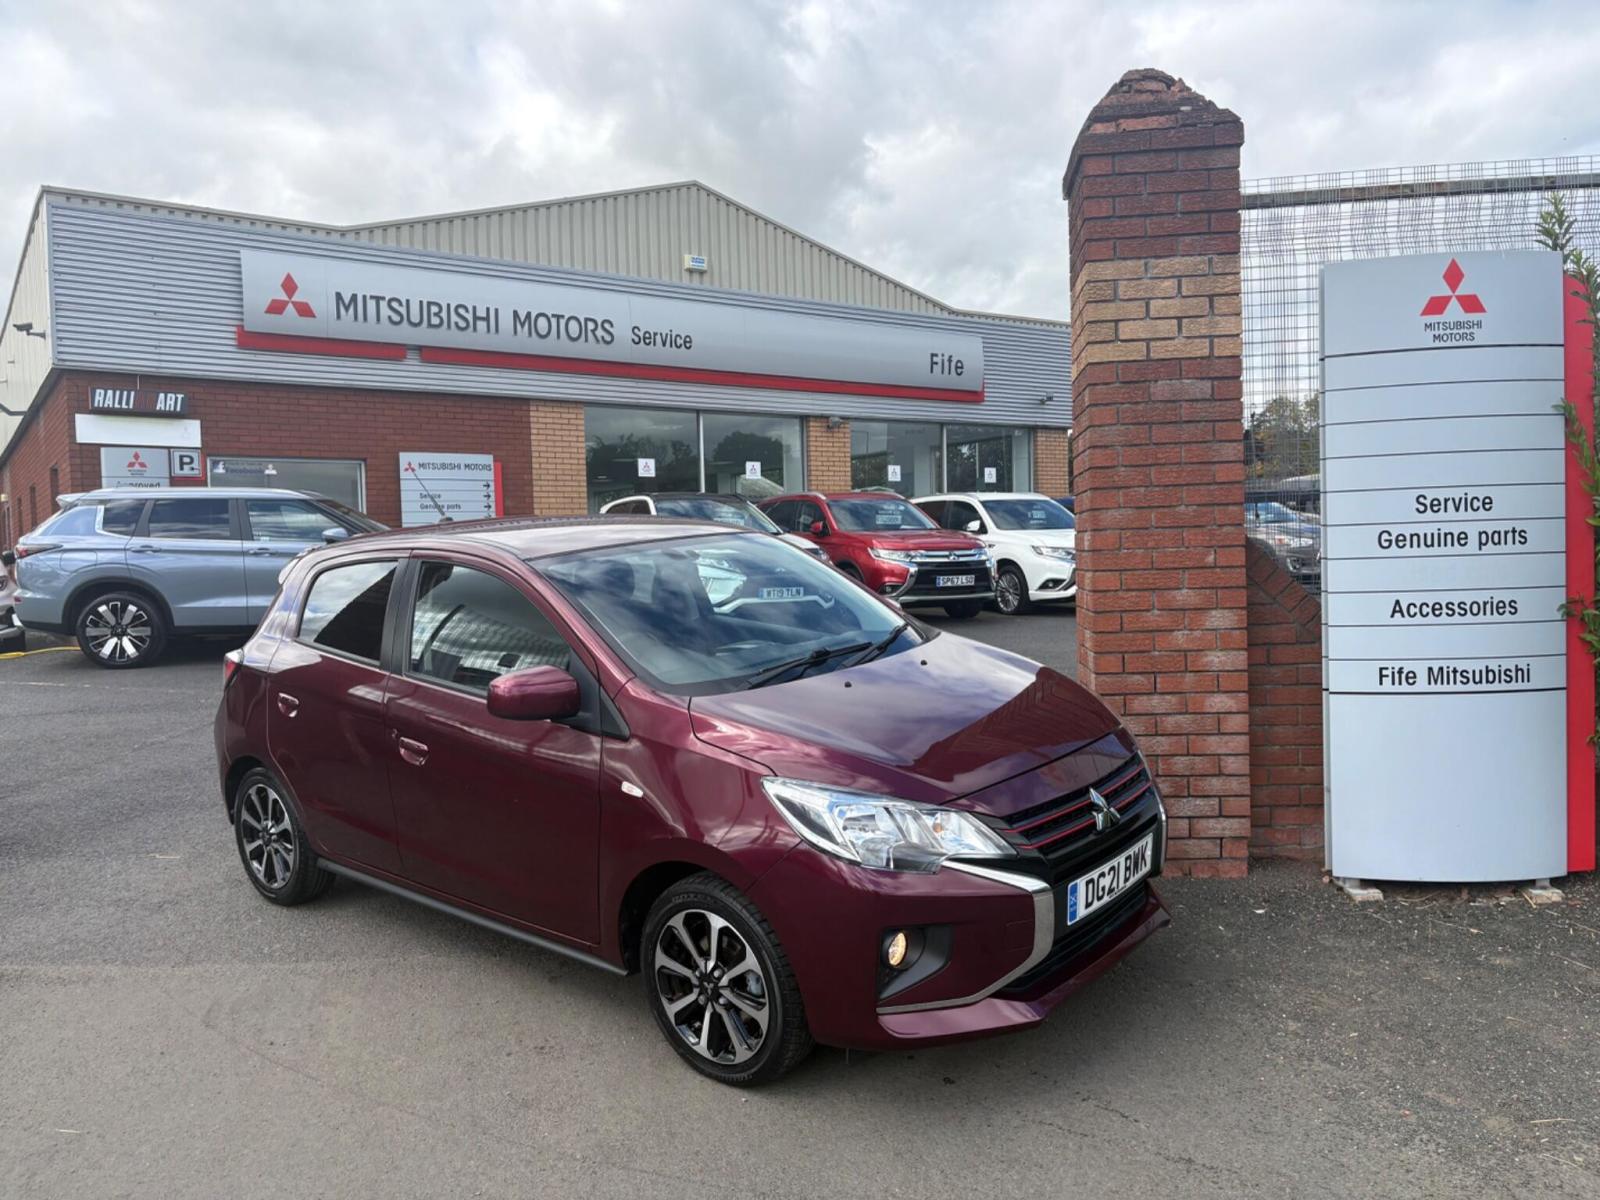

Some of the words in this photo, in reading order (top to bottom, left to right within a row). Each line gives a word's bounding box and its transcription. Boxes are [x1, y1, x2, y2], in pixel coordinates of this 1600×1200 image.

[335, 291, 499, 336] MITSUBISHI
[512, 309, 615, 346] MOTORS
[631, 325, 694, 351] Service
[1424, 320, 1483, 332] MITSUBISHI
[1432, 331, 1476, 343] MOTORS
[930, 352, 964, 376] Fife
[94, 389, 135, 409] RALLI
[156, 393, 185, 412] ART
[179, 455, 194, 471] P
[418, 462, 462, 471] MITSUBISHI
[464, 463, 492, 472] MOTORS
[1415, 493, 1493, 515] Service
[1377, 528, 1468, 550] Genuine
[1477, 525, 1528, 552] parts
[1390, 594, 1518, 619] Accessories
[1378, 666, 1418, 687] Fife
[1427, 663, 1531, 686] Mitsubishi
[1085, 861, 1121, 910] DG21
[1124, 841, 1148, 884] BWK
